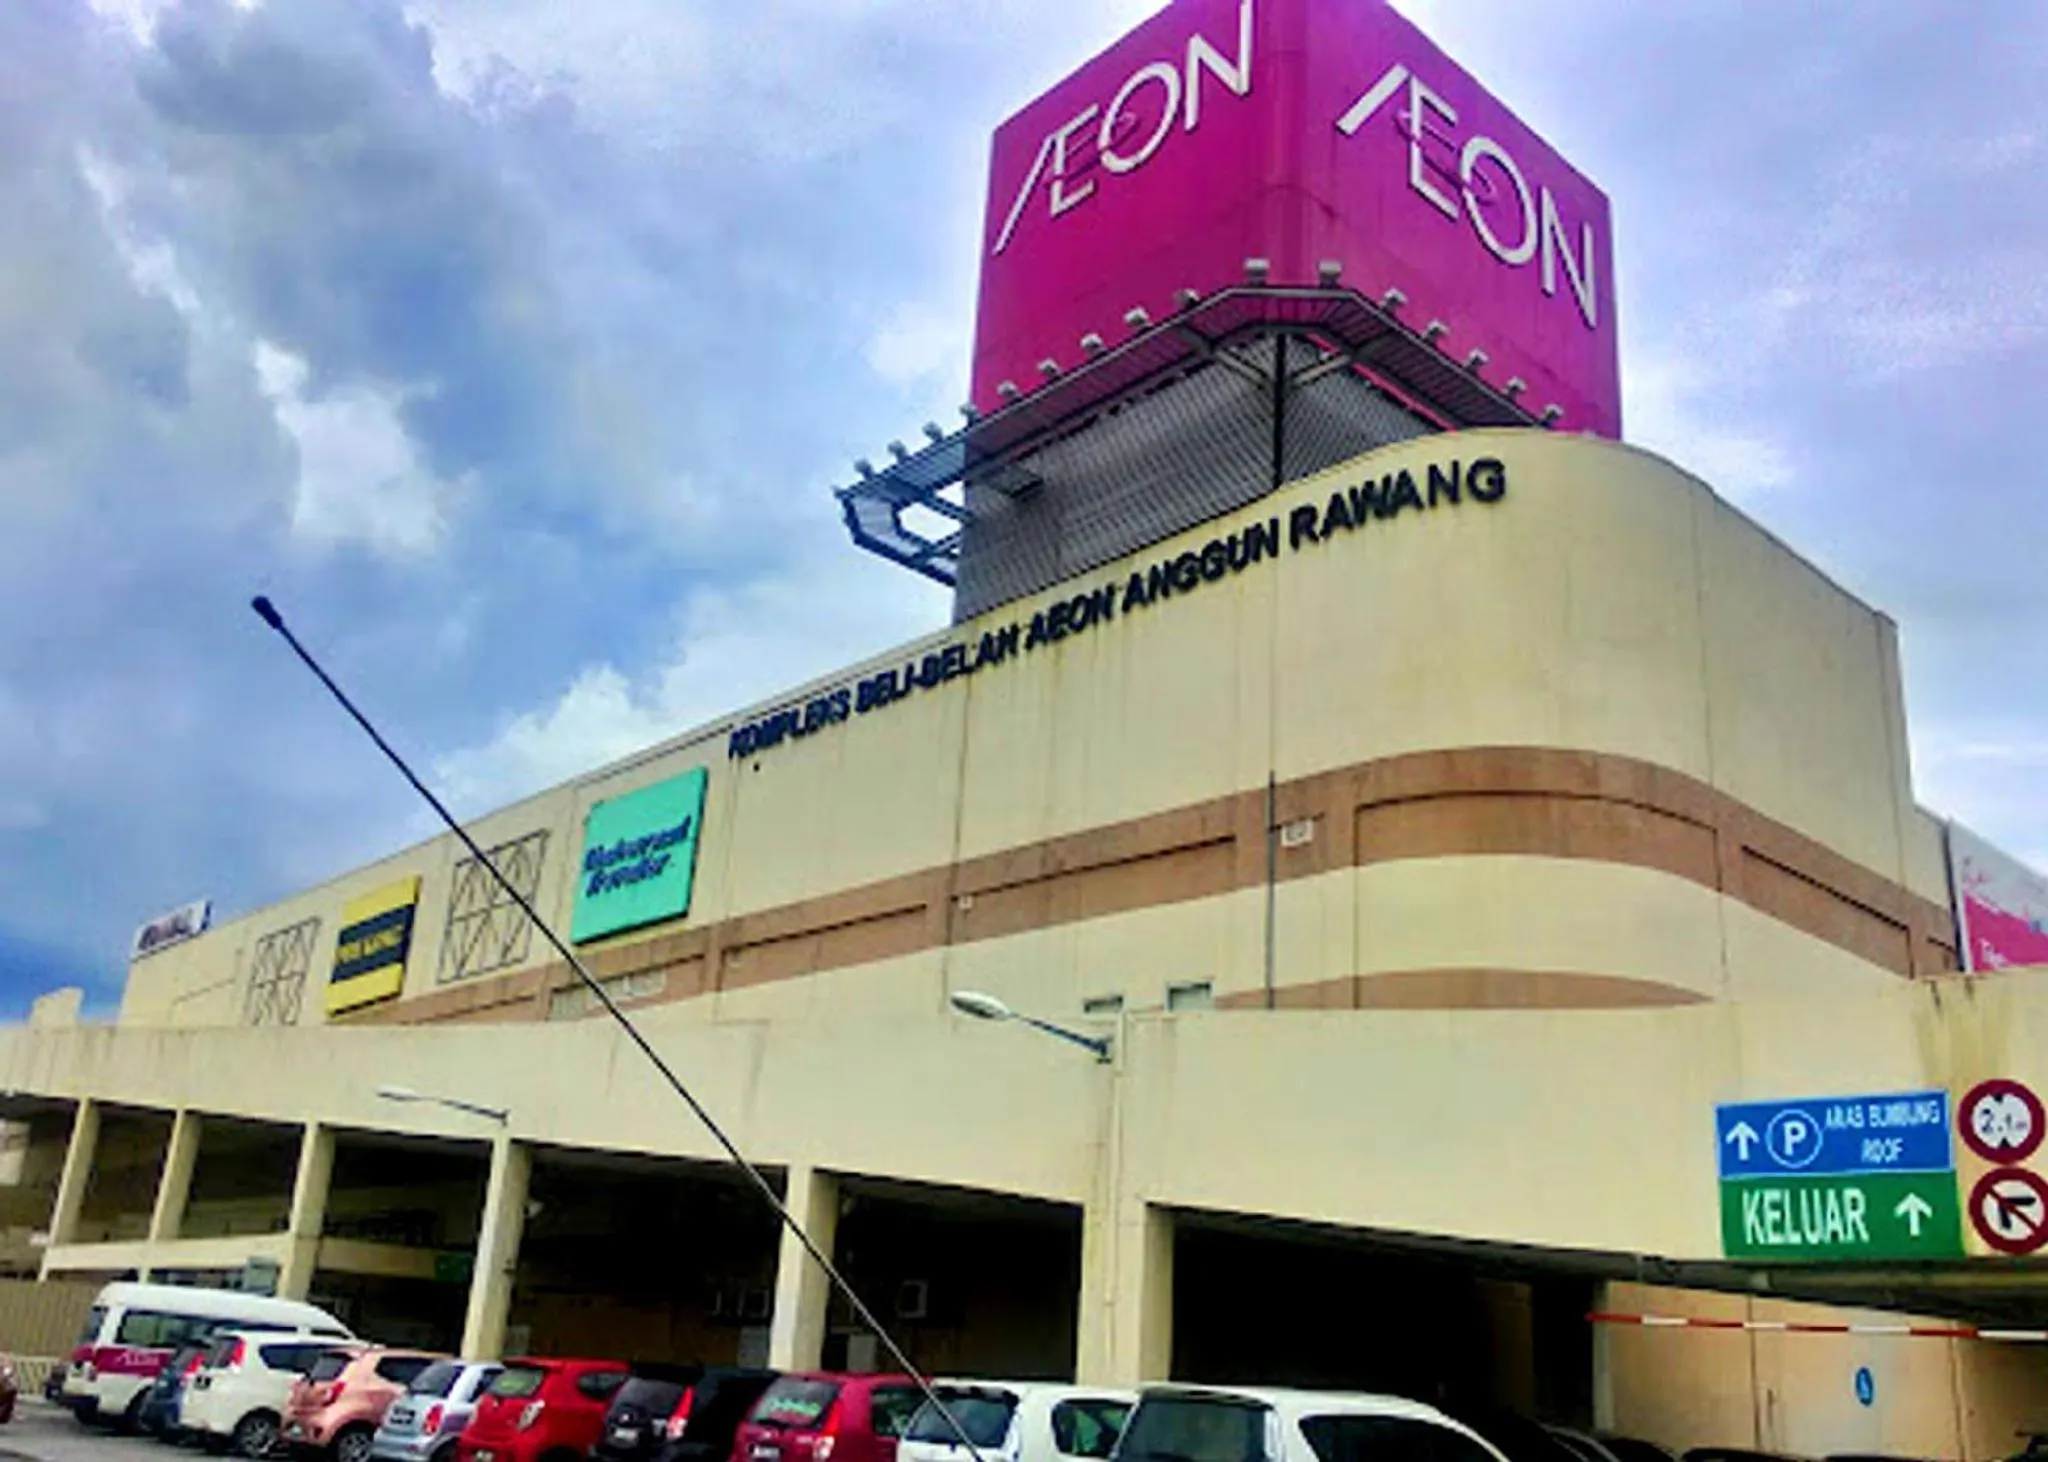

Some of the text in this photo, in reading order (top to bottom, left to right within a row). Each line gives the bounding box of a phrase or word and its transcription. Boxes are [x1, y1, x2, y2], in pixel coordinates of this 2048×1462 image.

[1336, 63, 1596, 330] AEON
[1025, 583, 1115, 652] AEON
[1122, 517, 1280, 614] ANGGUN
[1289, 457, 1507, 551] RAWANG
[1742, 1187, 1869, 1245] KELUAR
